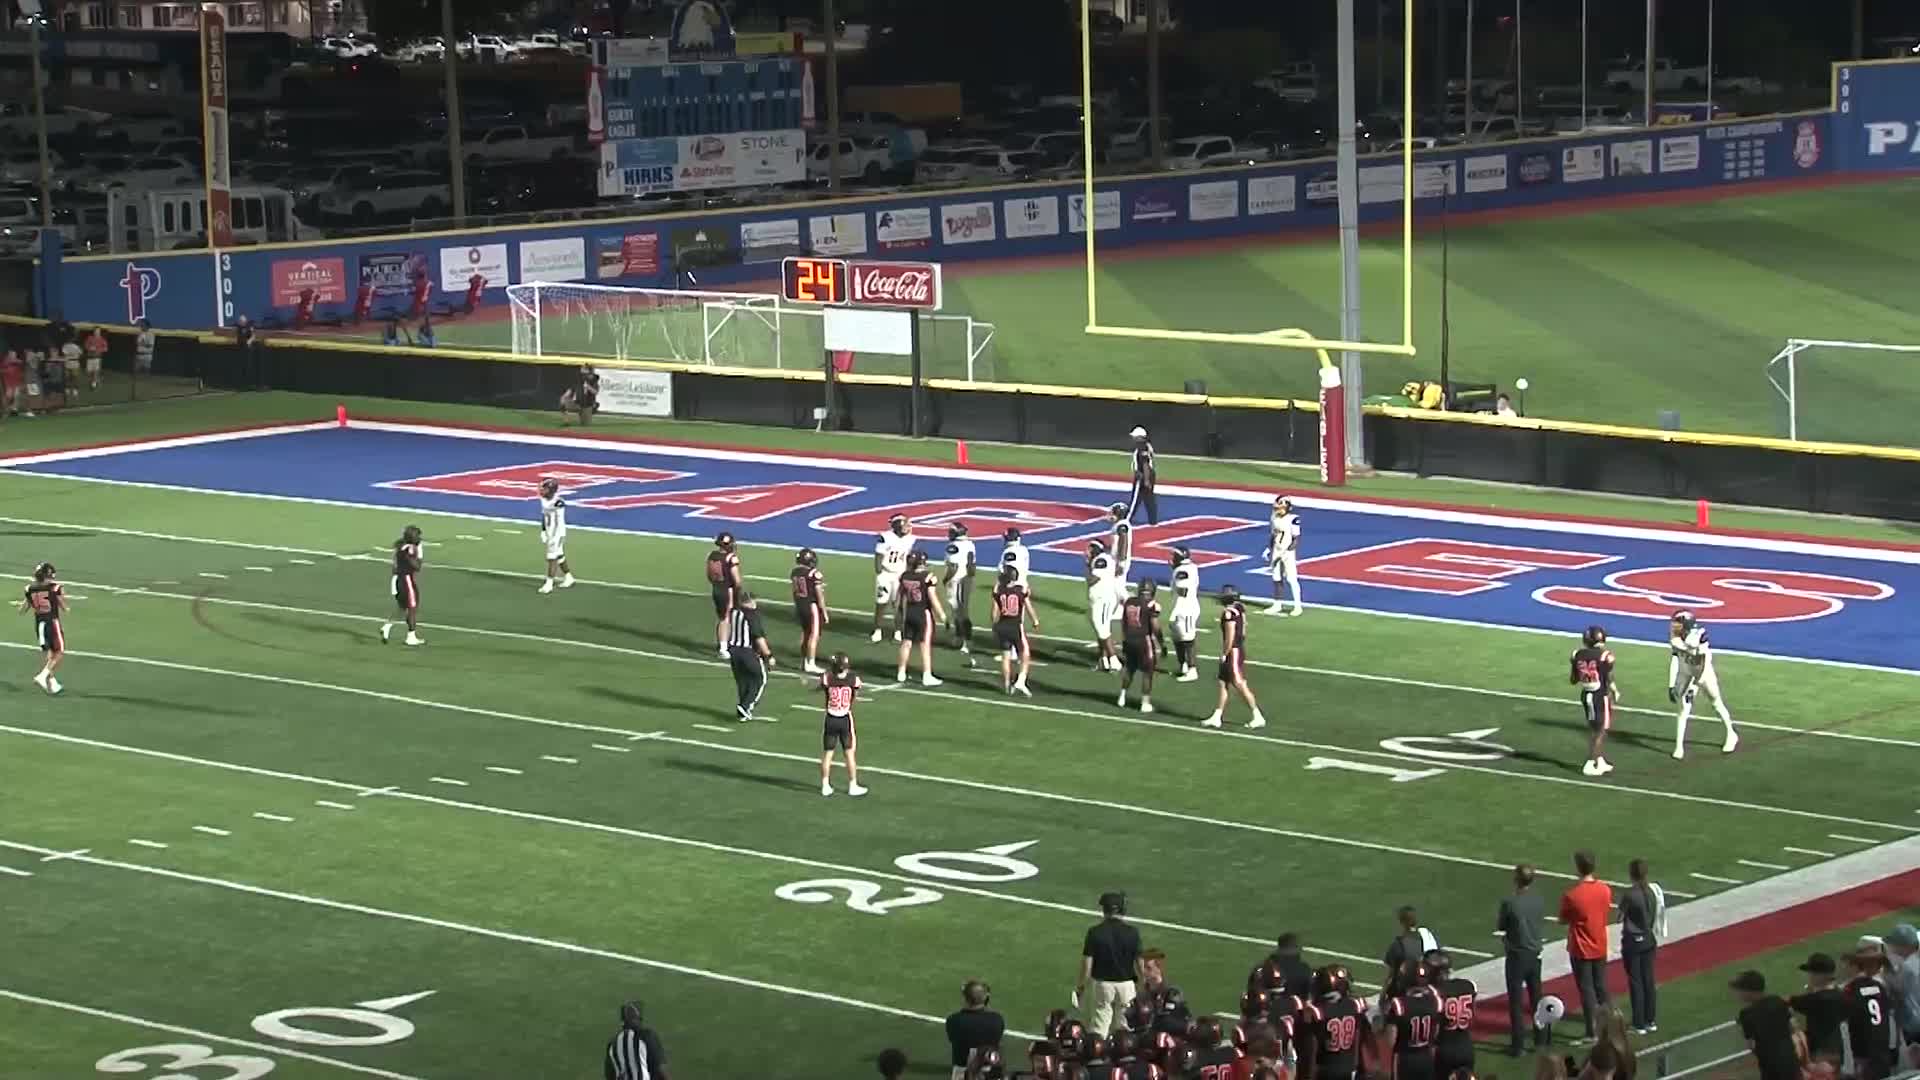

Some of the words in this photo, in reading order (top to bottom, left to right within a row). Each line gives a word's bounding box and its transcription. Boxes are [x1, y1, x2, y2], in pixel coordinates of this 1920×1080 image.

[222, 254, 234, 318] 300
[797, 261, 835, 303] 24
[1000, 593, 1019, 617] 10
[775, 850, 1039, 915] 20
[1445, 995, 1473, 1031] 95
[1867, 998, 1882, 1026] 9
